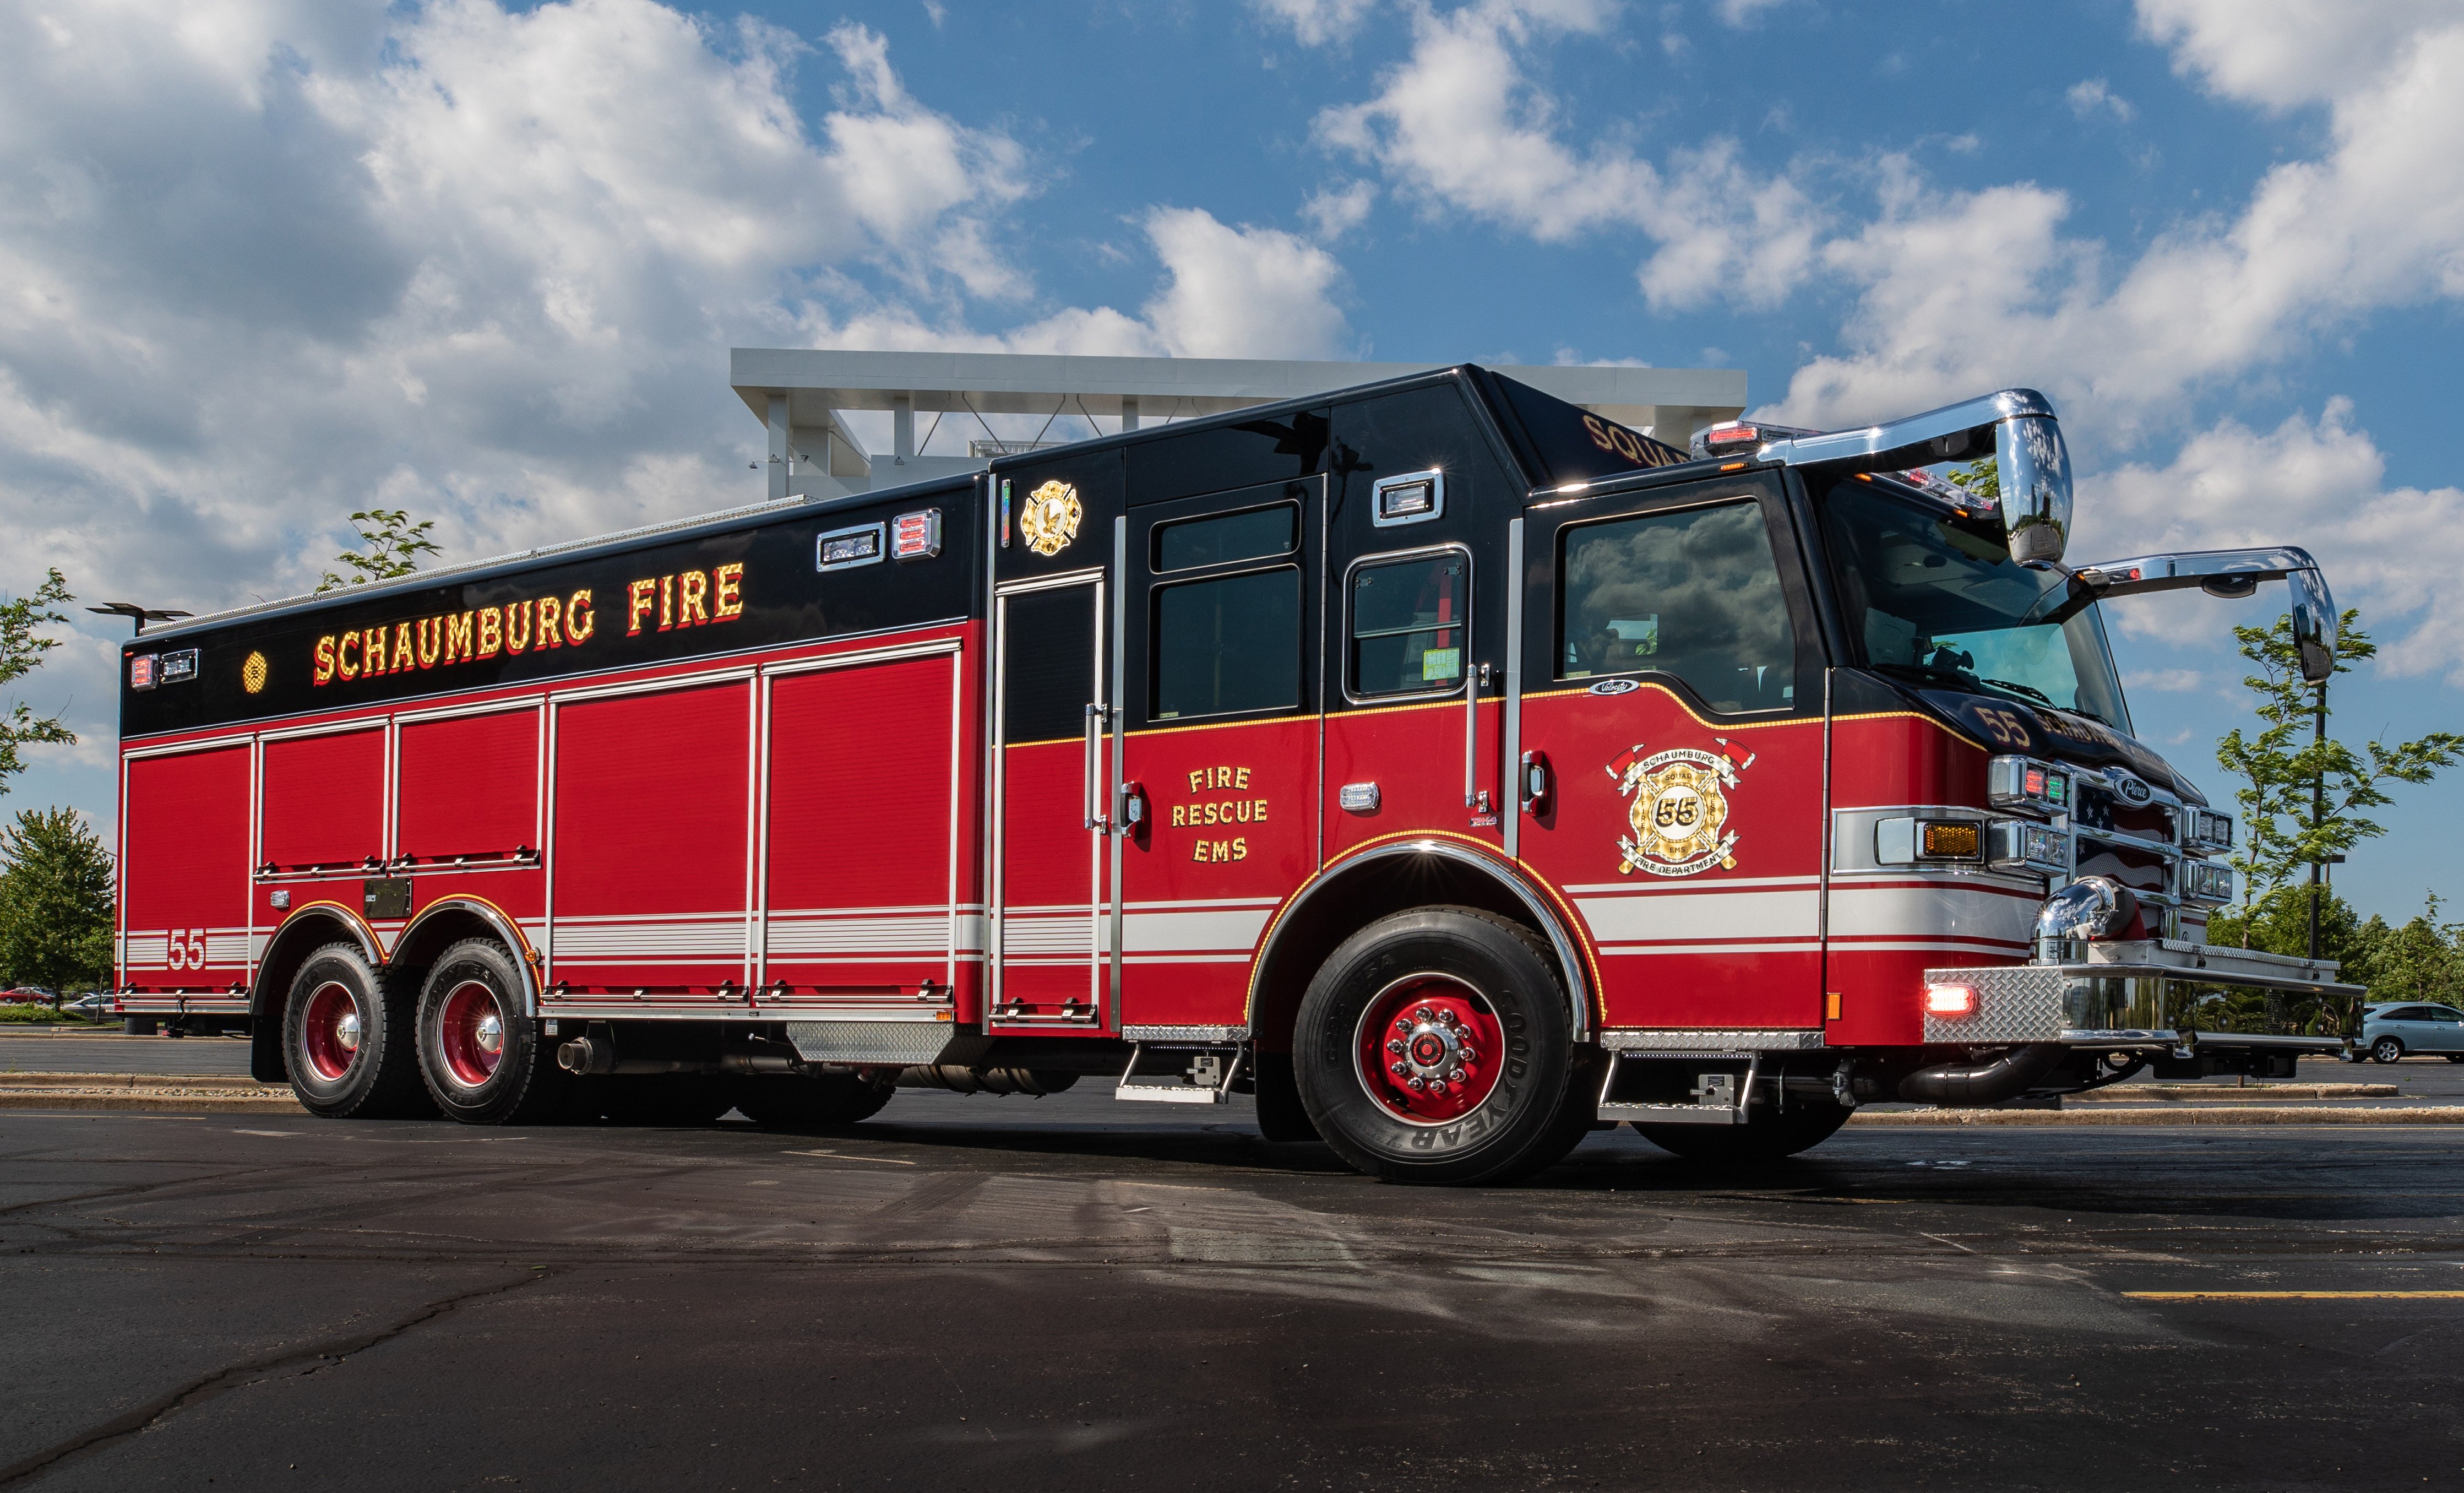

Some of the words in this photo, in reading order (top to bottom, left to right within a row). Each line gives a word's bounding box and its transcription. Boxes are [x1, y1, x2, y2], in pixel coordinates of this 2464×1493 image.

[313, 589, 595, 687] SCHAUMBURG
[625, 562, 744, 637] FIRE
[1601, 681, 1628, 692] Velocity
[1974, 707, 2031, 751] 55
[1643, 751, 1715, 769] SCHAUMBURG
[1188, 765, 1251, 795] FIRE
[1665, 773, 1692, 781] SQUAD
[2125, 779, 2147, 798] Pierce
[1171, 799, 1268, 828] RESCUE
[1655, 796, 1699, 827] 55
[1192, 837, 1248, 864] EMS
[1634, 856, 1655, 871] FIRE
[1658, 853, 1722, 874] DEPARTMENT
[168, 928, 205, 970] 55
[1411, 989, 1532, 1150] GOODYEAR
